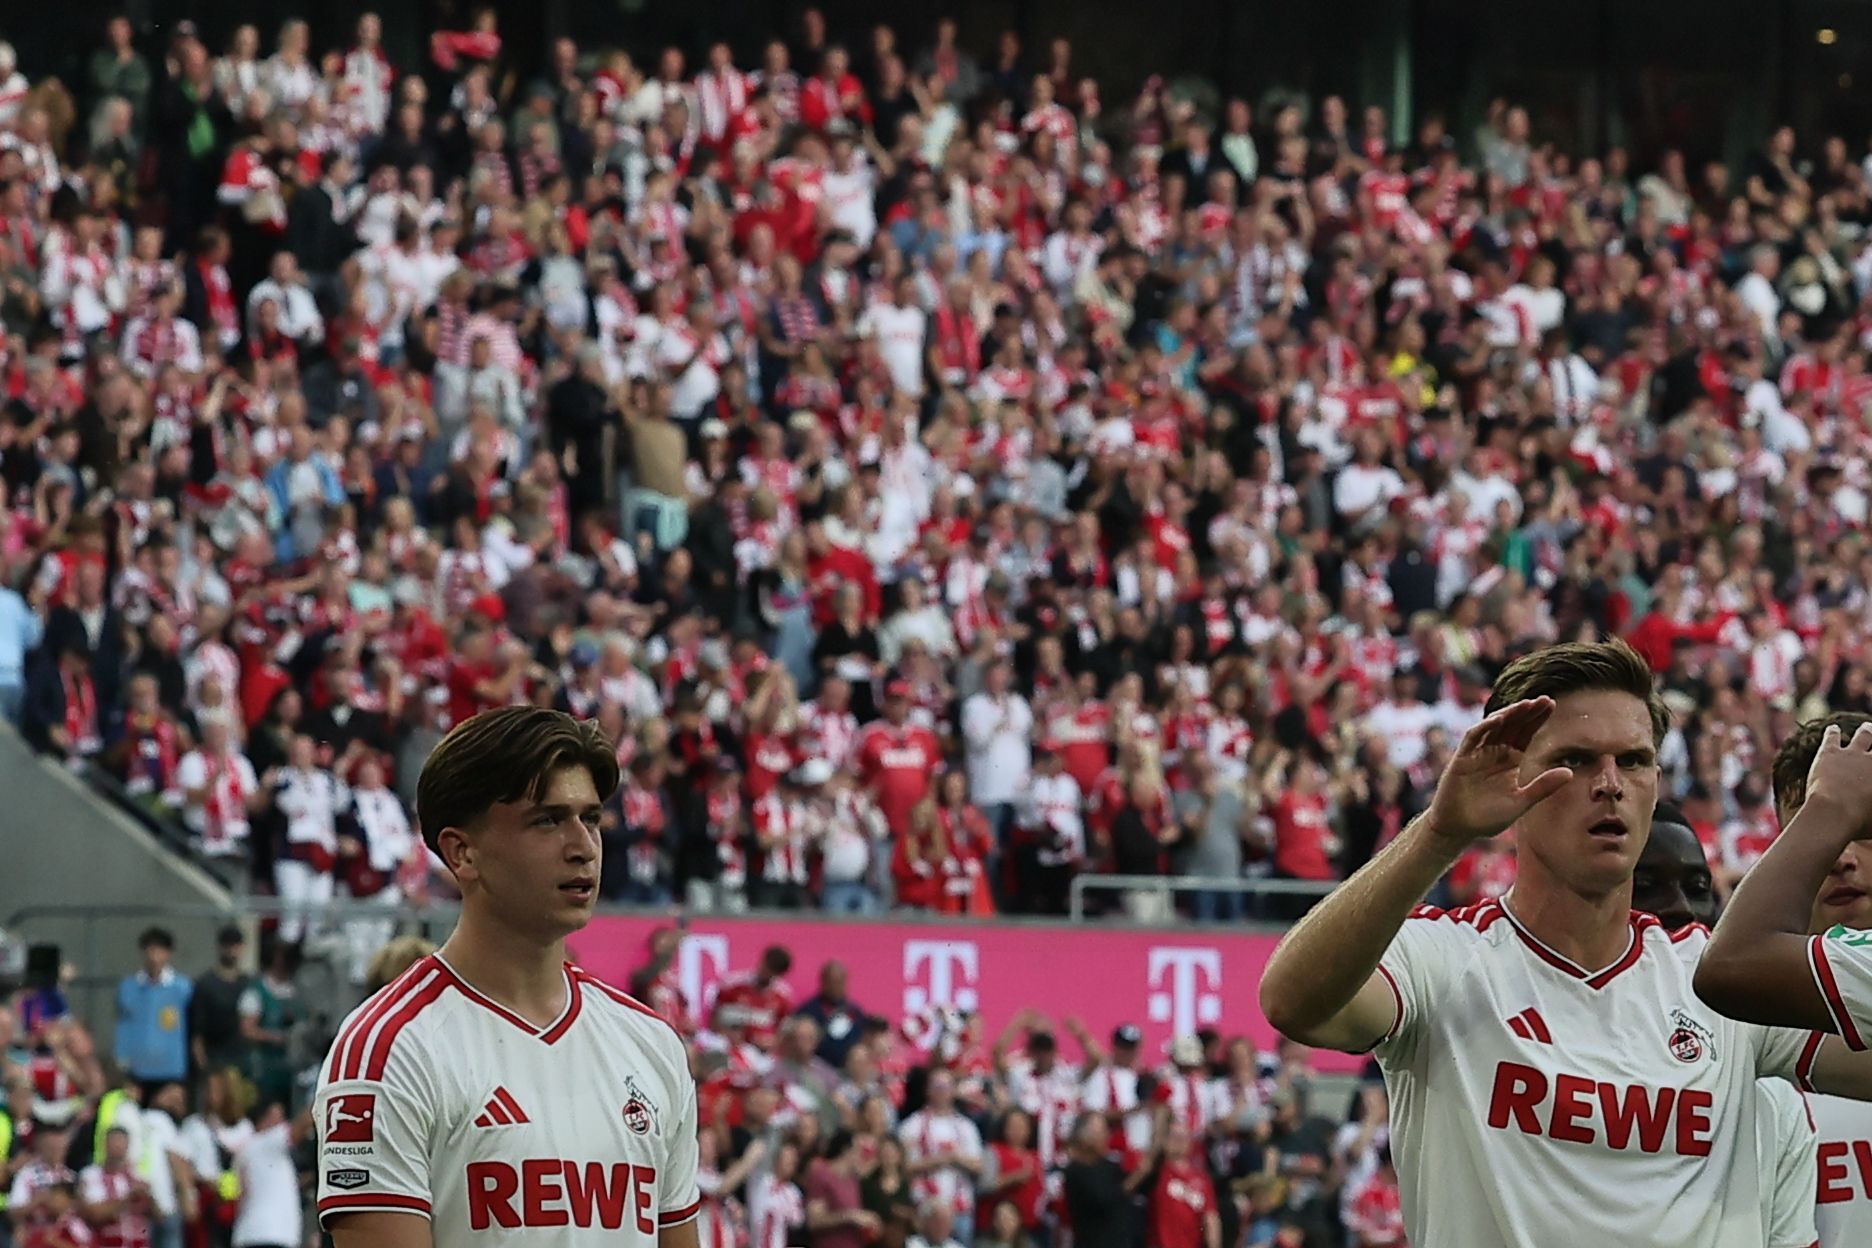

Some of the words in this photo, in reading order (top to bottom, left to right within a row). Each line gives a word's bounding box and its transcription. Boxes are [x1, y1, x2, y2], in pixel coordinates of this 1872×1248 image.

[904, 940, 979, 1013] T
[1148, 947, 1221, 1038] T
[1488, 1061, 1713, 1157] REWE
[466, 1159, 656, 1235] REWE
